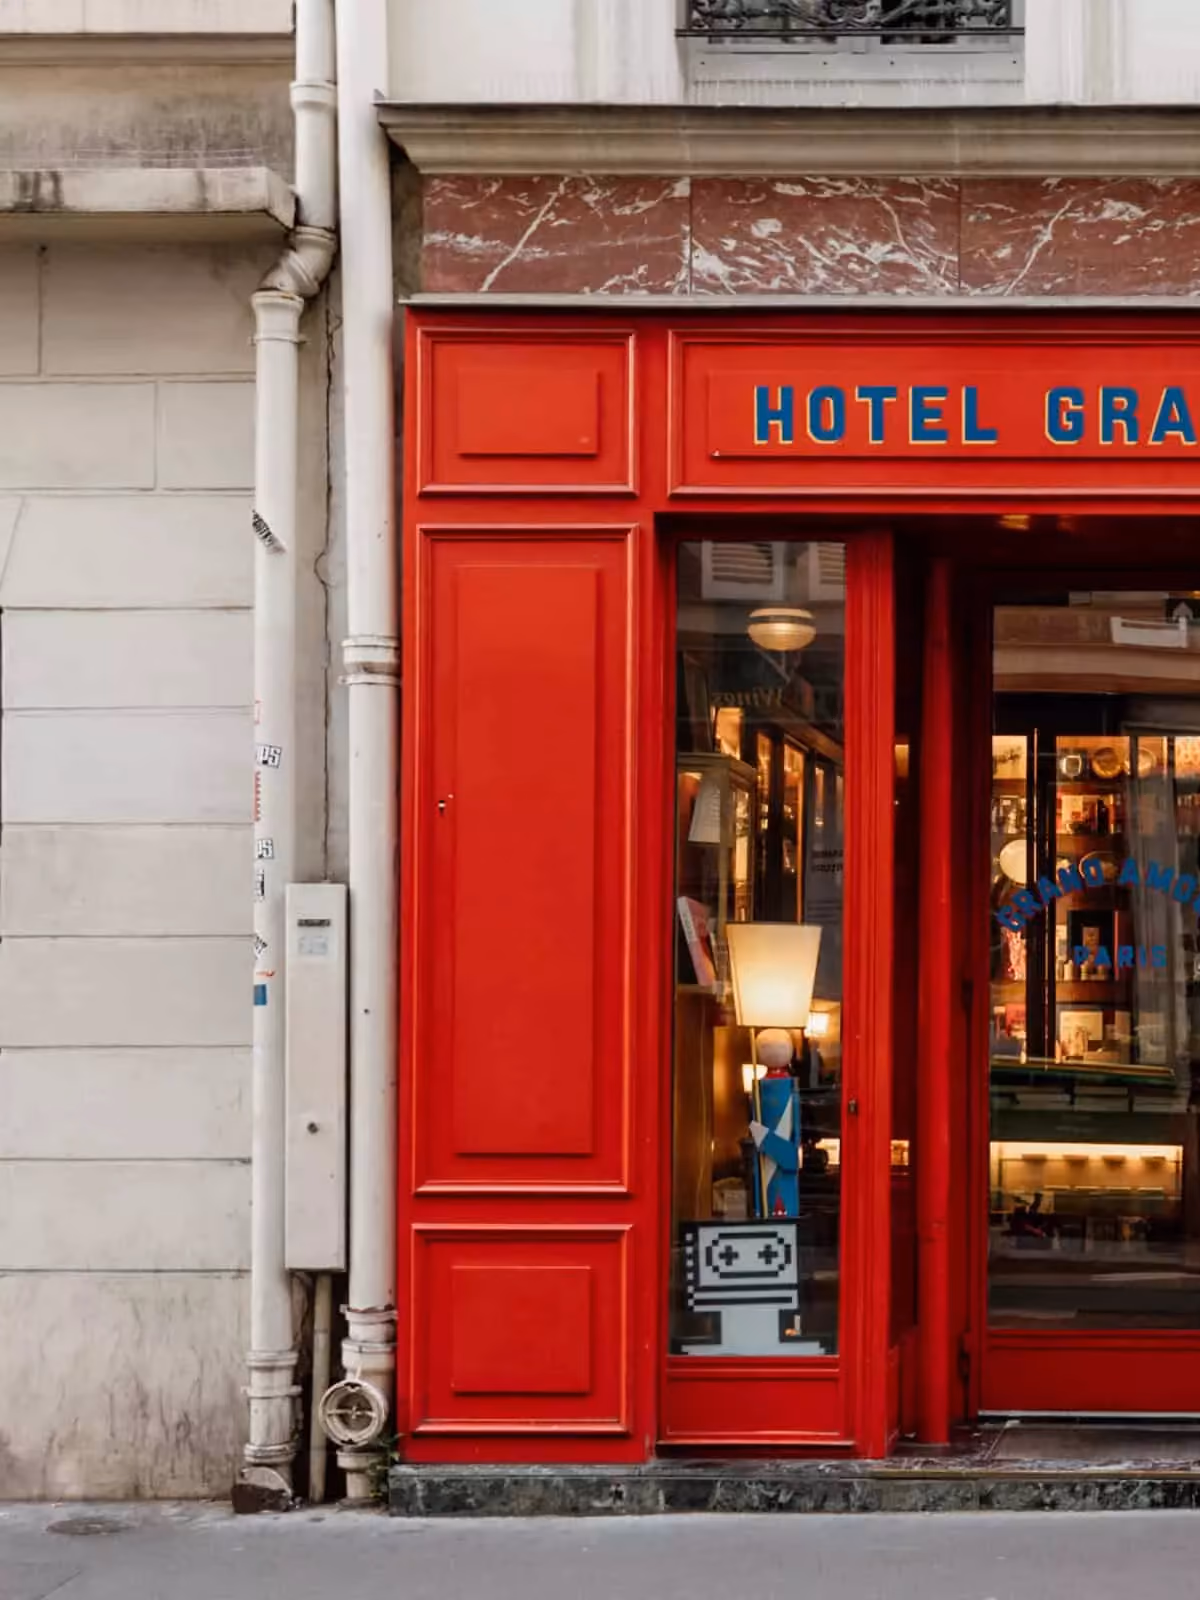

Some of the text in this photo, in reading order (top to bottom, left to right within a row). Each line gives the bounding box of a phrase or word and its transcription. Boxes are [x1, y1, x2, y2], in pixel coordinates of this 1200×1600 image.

[753, 385, 999, 445] HOTEL
[995, 857, 1106, 932] GRAND
[1073, 945, 1168, 968] PARIS
